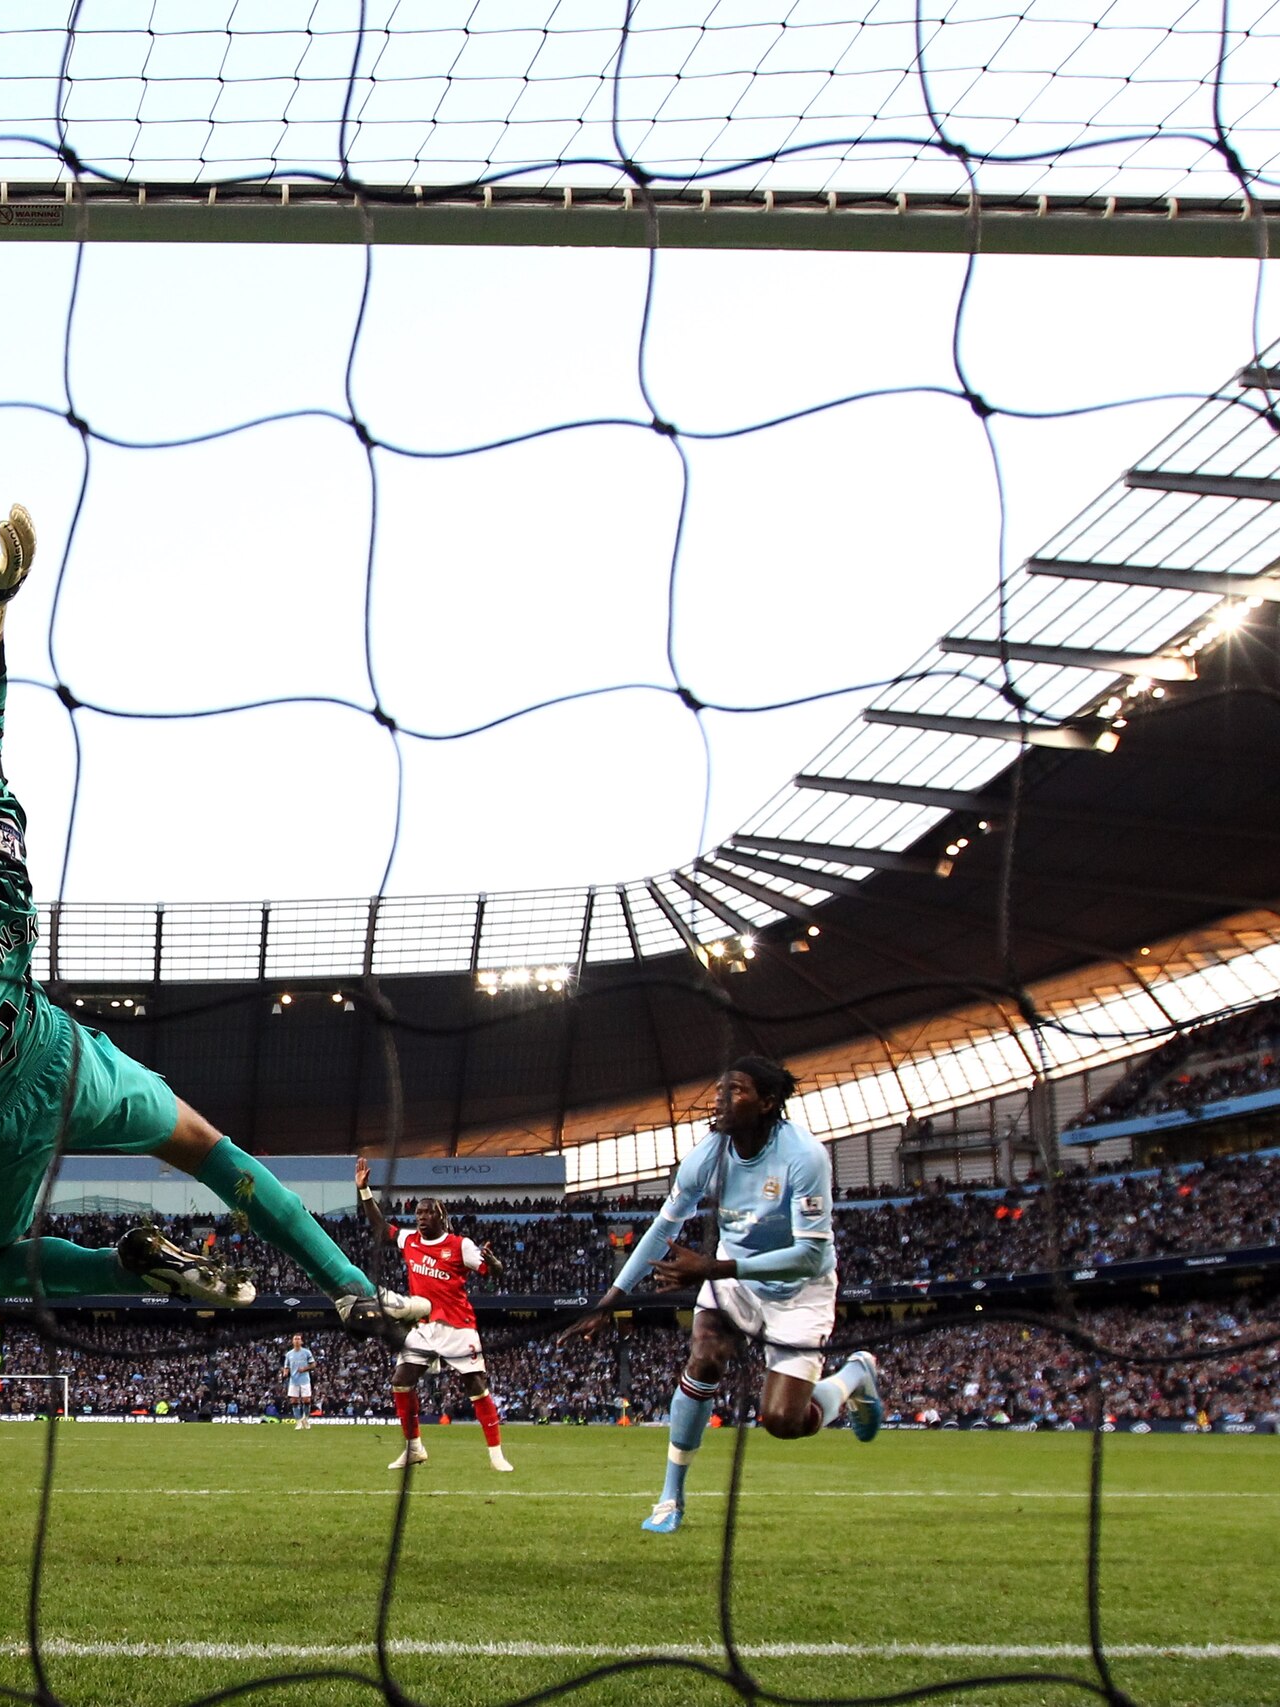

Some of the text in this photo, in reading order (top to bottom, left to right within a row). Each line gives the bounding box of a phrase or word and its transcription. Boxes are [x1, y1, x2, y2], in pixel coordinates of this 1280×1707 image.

[432, 1165, 491, 1174] ETIHAD
[423, 1255, 436, 1267] Fly
[468, 1344, 478, 1360] 3
